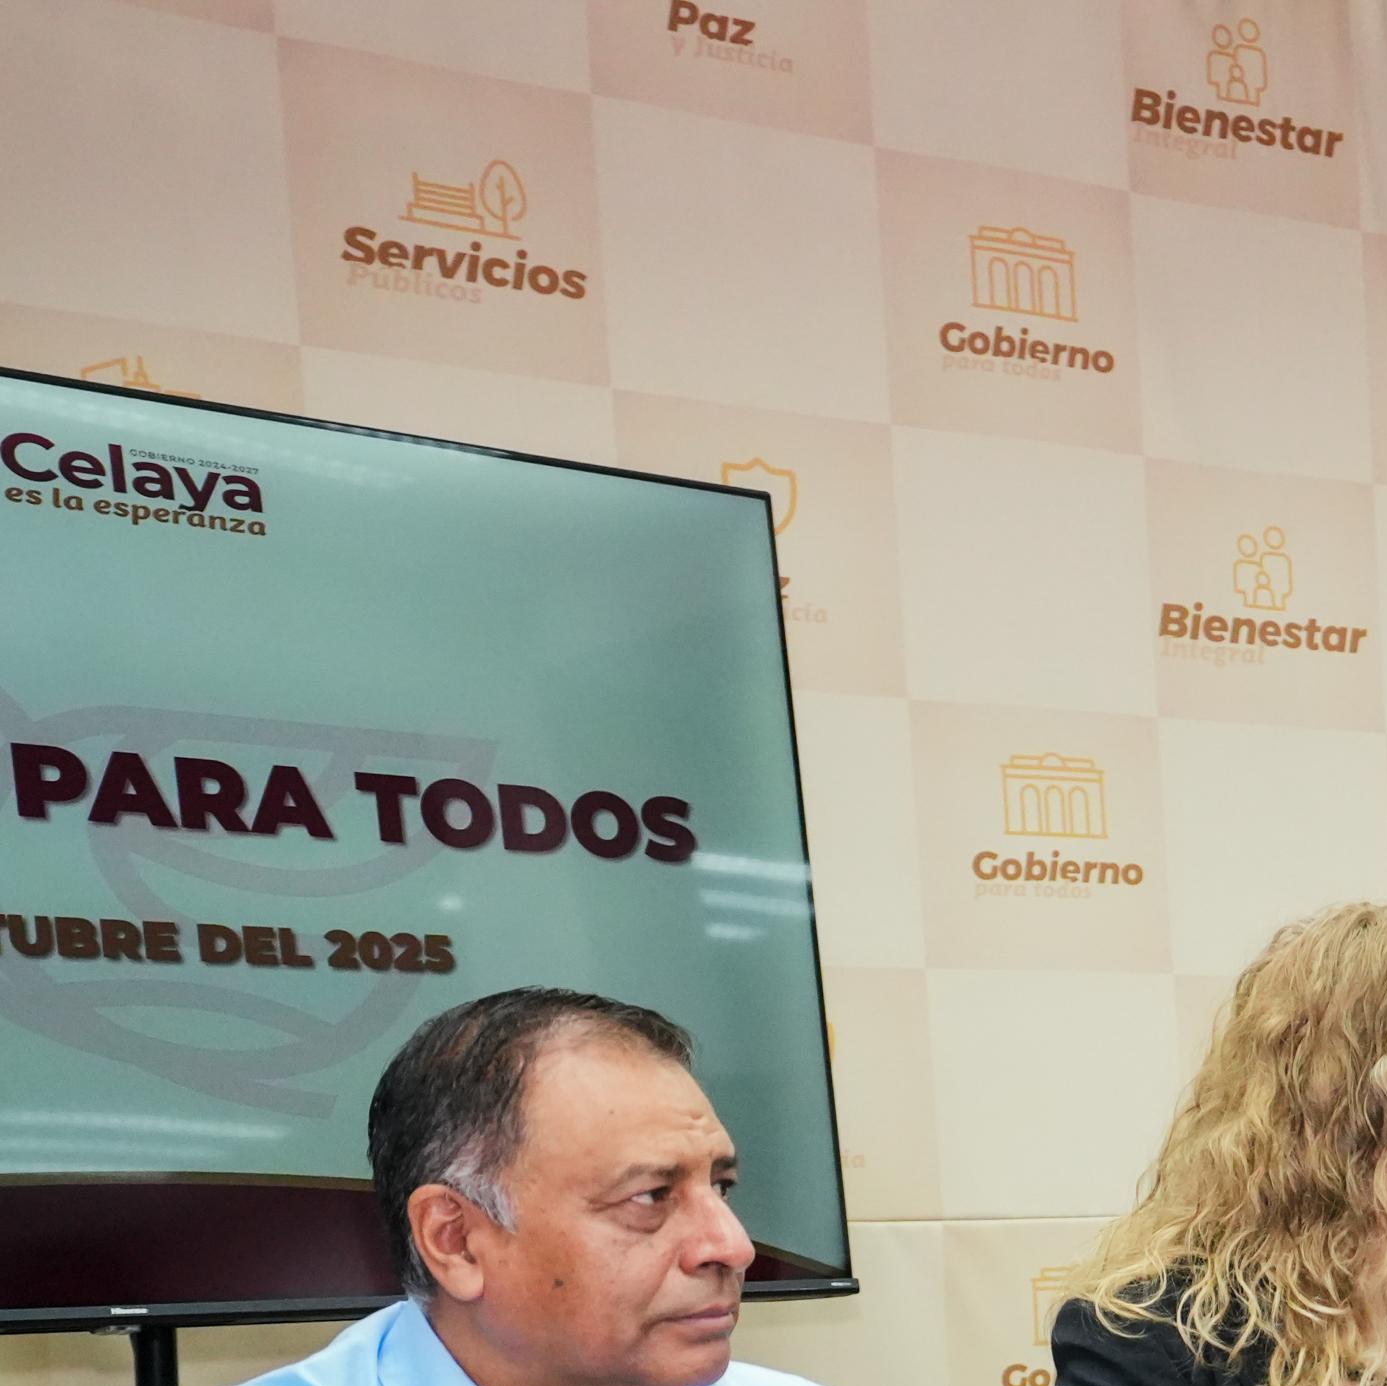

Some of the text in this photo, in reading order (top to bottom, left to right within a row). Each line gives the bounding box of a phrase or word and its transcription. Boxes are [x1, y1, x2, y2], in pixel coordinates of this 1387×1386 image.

[667, 0, 755, 47] Paz
[694, 34, 793, 73] Justicia
[1132, 88, 1343, 158] Bienestar
[1136, 127, 1237, 159] Integral
[342, 227, 587, 299] Servicios
[940, 322, 1115, 373] Gobierno
[1, 432, 264, 513] Celaya
[129, 449, 259, 475] GOBIERNO 2024-2027
[5, 486, 267, 536] es la esperanza
[1159, 602, 1367, 654] Bienestar
[1162, 639, 1264, 667] Integral
[10, 741, 698, 863] PARA TODOS
[973, 850, 1143, 886] Gobierno
[198, 923, 313, 968] DEL
[324, 930, 457, 974] 2025
